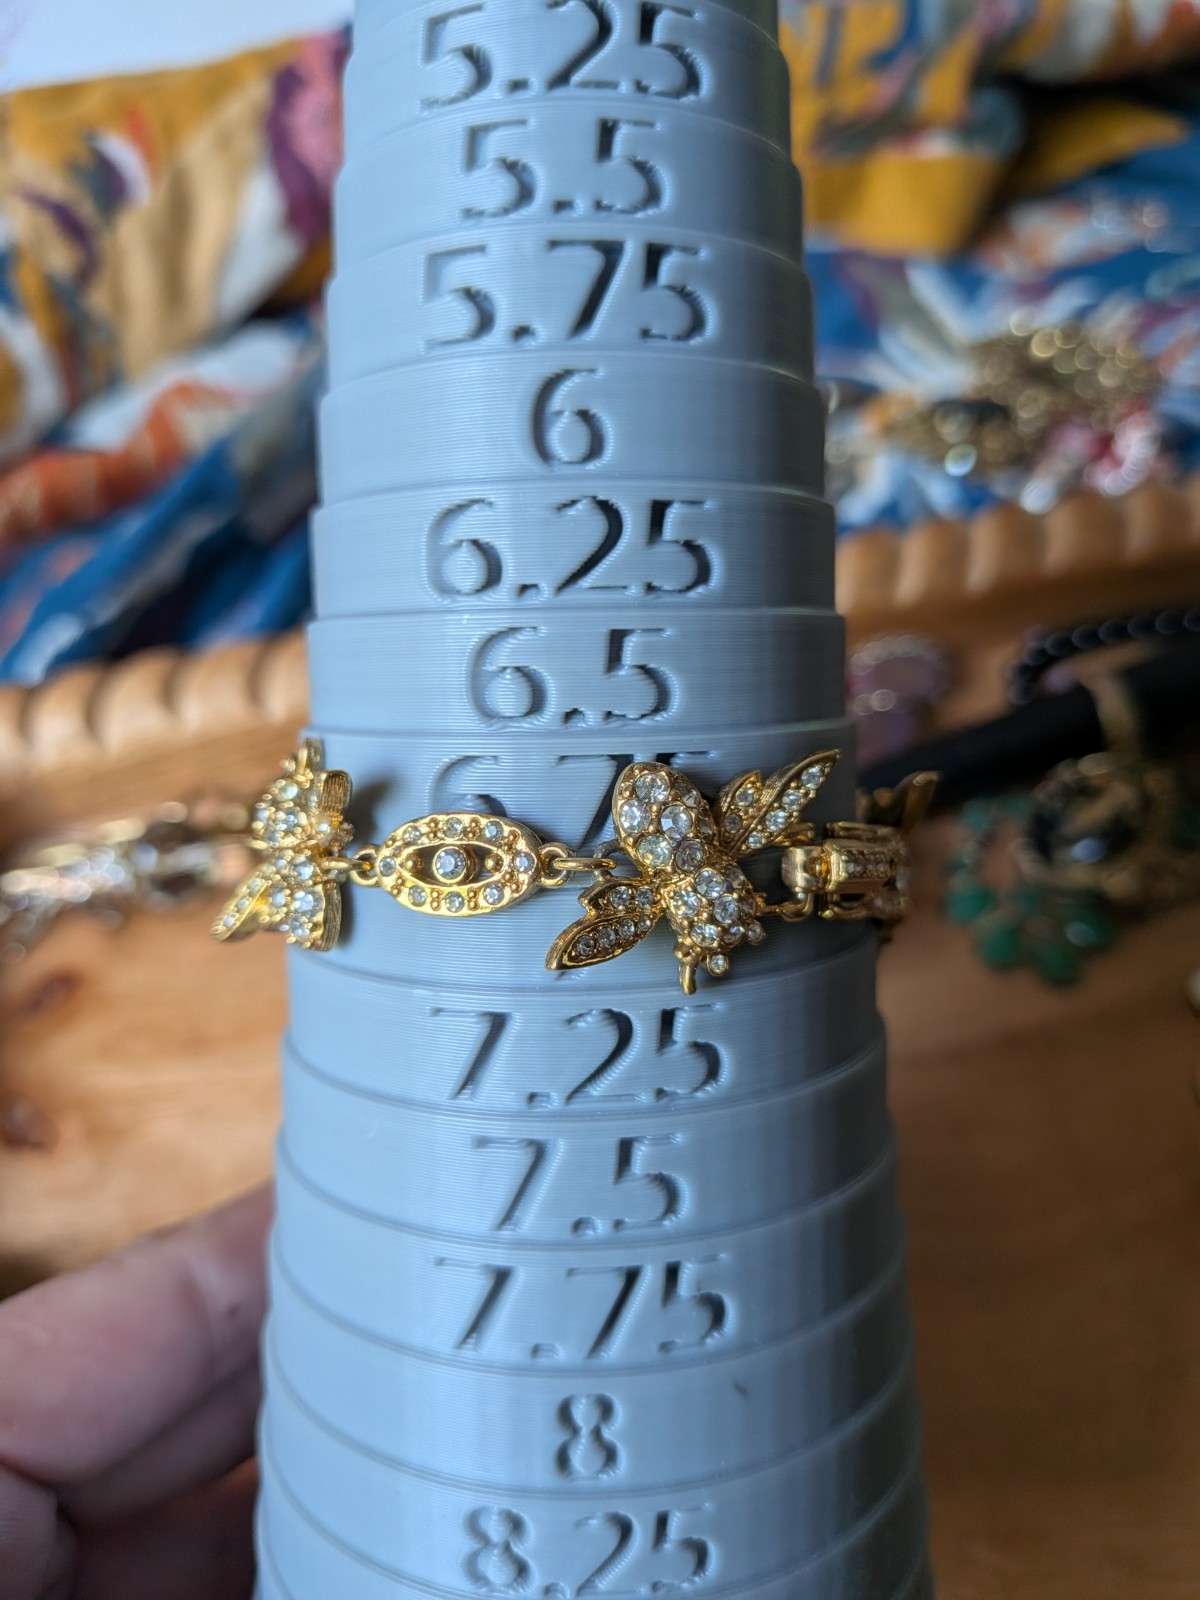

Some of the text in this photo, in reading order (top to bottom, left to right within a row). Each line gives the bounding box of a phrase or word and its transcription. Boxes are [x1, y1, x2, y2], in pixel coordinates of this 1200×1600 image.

[416, 0, 708, 114] 5.25
[459, 118, 672, 218] 5.5
[419, 240, 714, 355] 5.75
[530, 368, 614, 470] 6
[423, 496, 720, 604] 6.25
[464, 626, 680, 727] 6.5
[429, 1002, 729, 1105] 7.25
[472, 1132, 690, 1234] 7.5
[432, 1252, 734, 1359] 7.75
[554, 1392, 625, 1480] 8
[461, 1502, 716, 1599] 8.25
